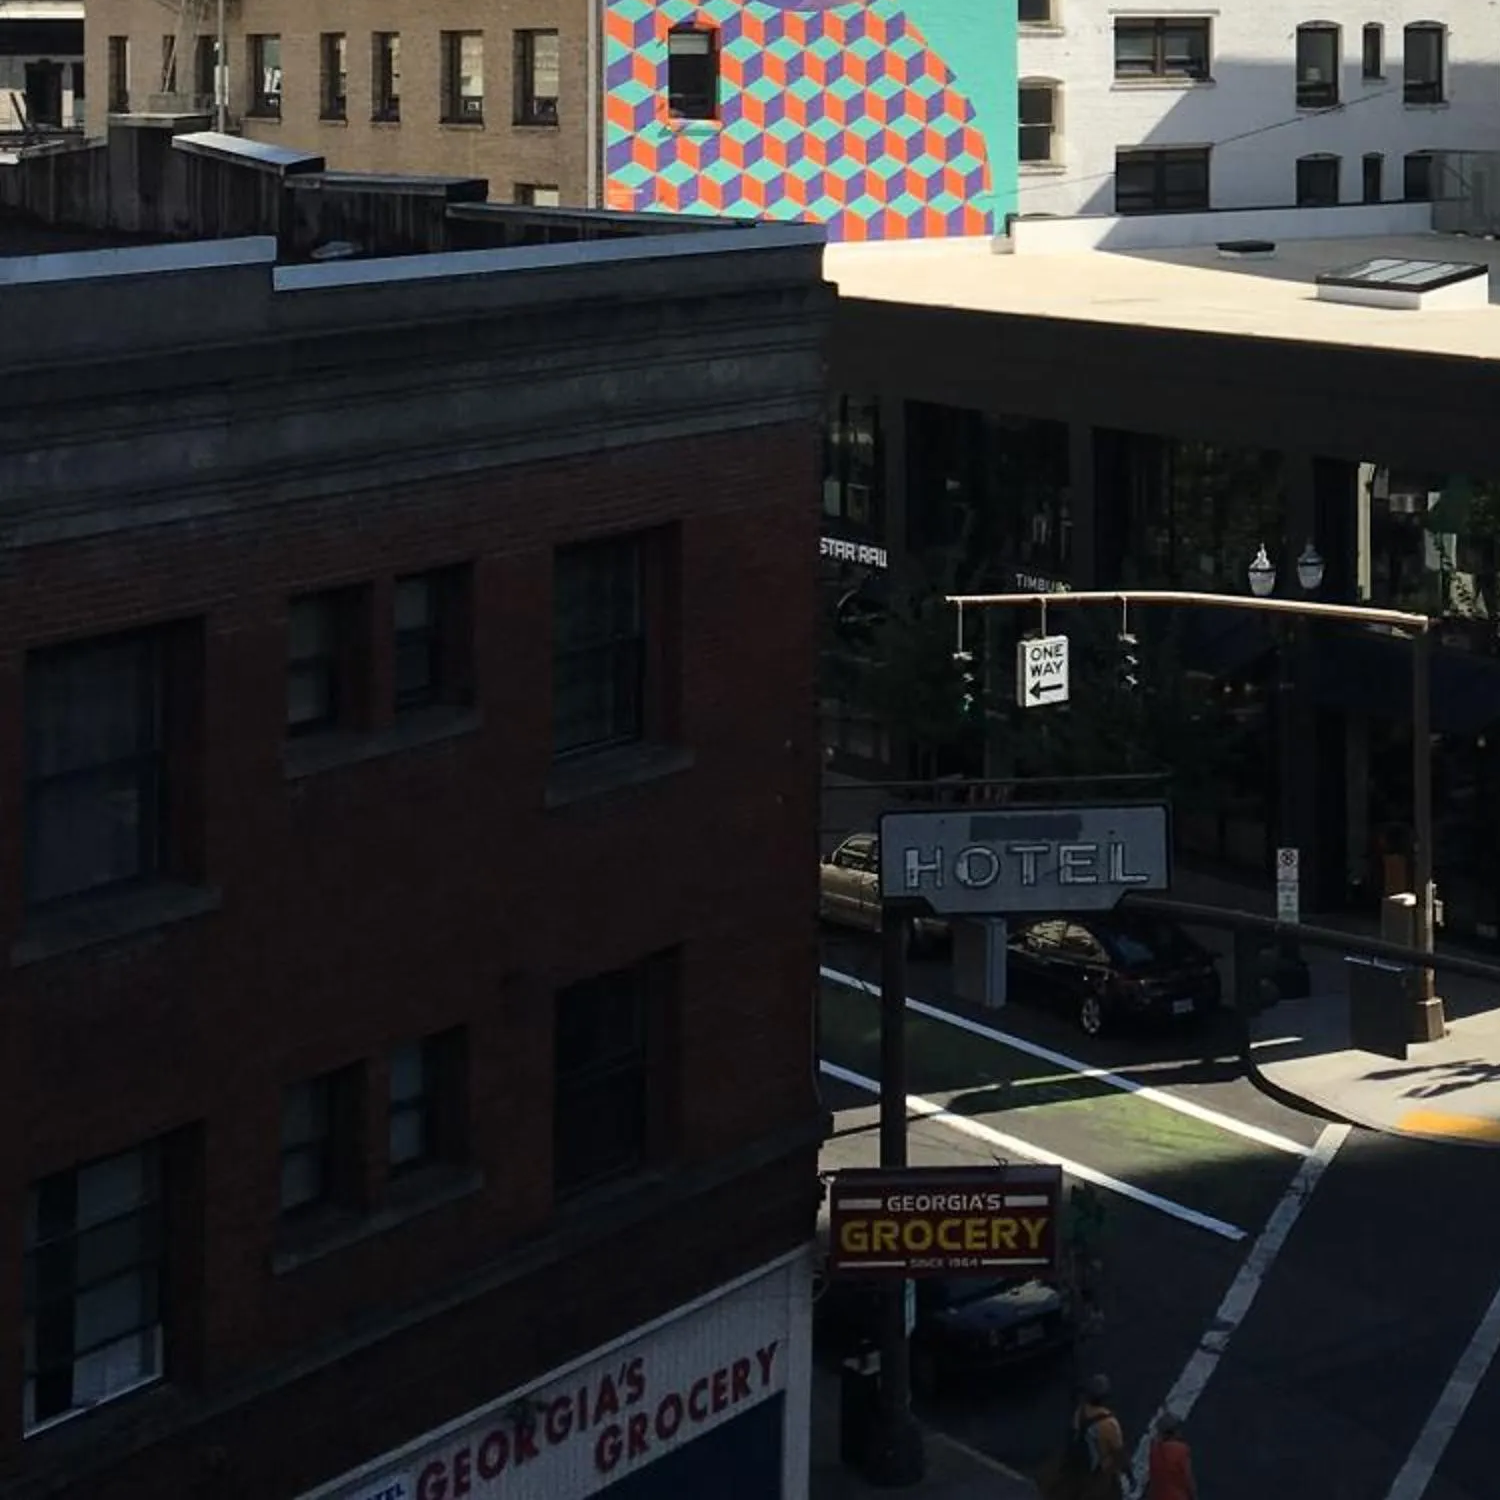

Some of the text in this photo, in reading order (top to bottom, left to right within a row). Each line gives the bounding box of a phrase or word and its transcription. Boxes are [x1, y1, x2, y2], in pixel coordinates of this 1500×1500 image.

[1030, 661, 1064, 677] WAY
[1031, 644, 1064, 661] ONE
[904, 842, 1150, 889] HOTEL
[887, 1194, 1002, 1212] GEORGIA'S
[840, 1217, 1048, 1253] GROCERY
[596, 1341, 778, 1474] GROCERY
[417, 1357, 645, 1500] GEORGIA'S
